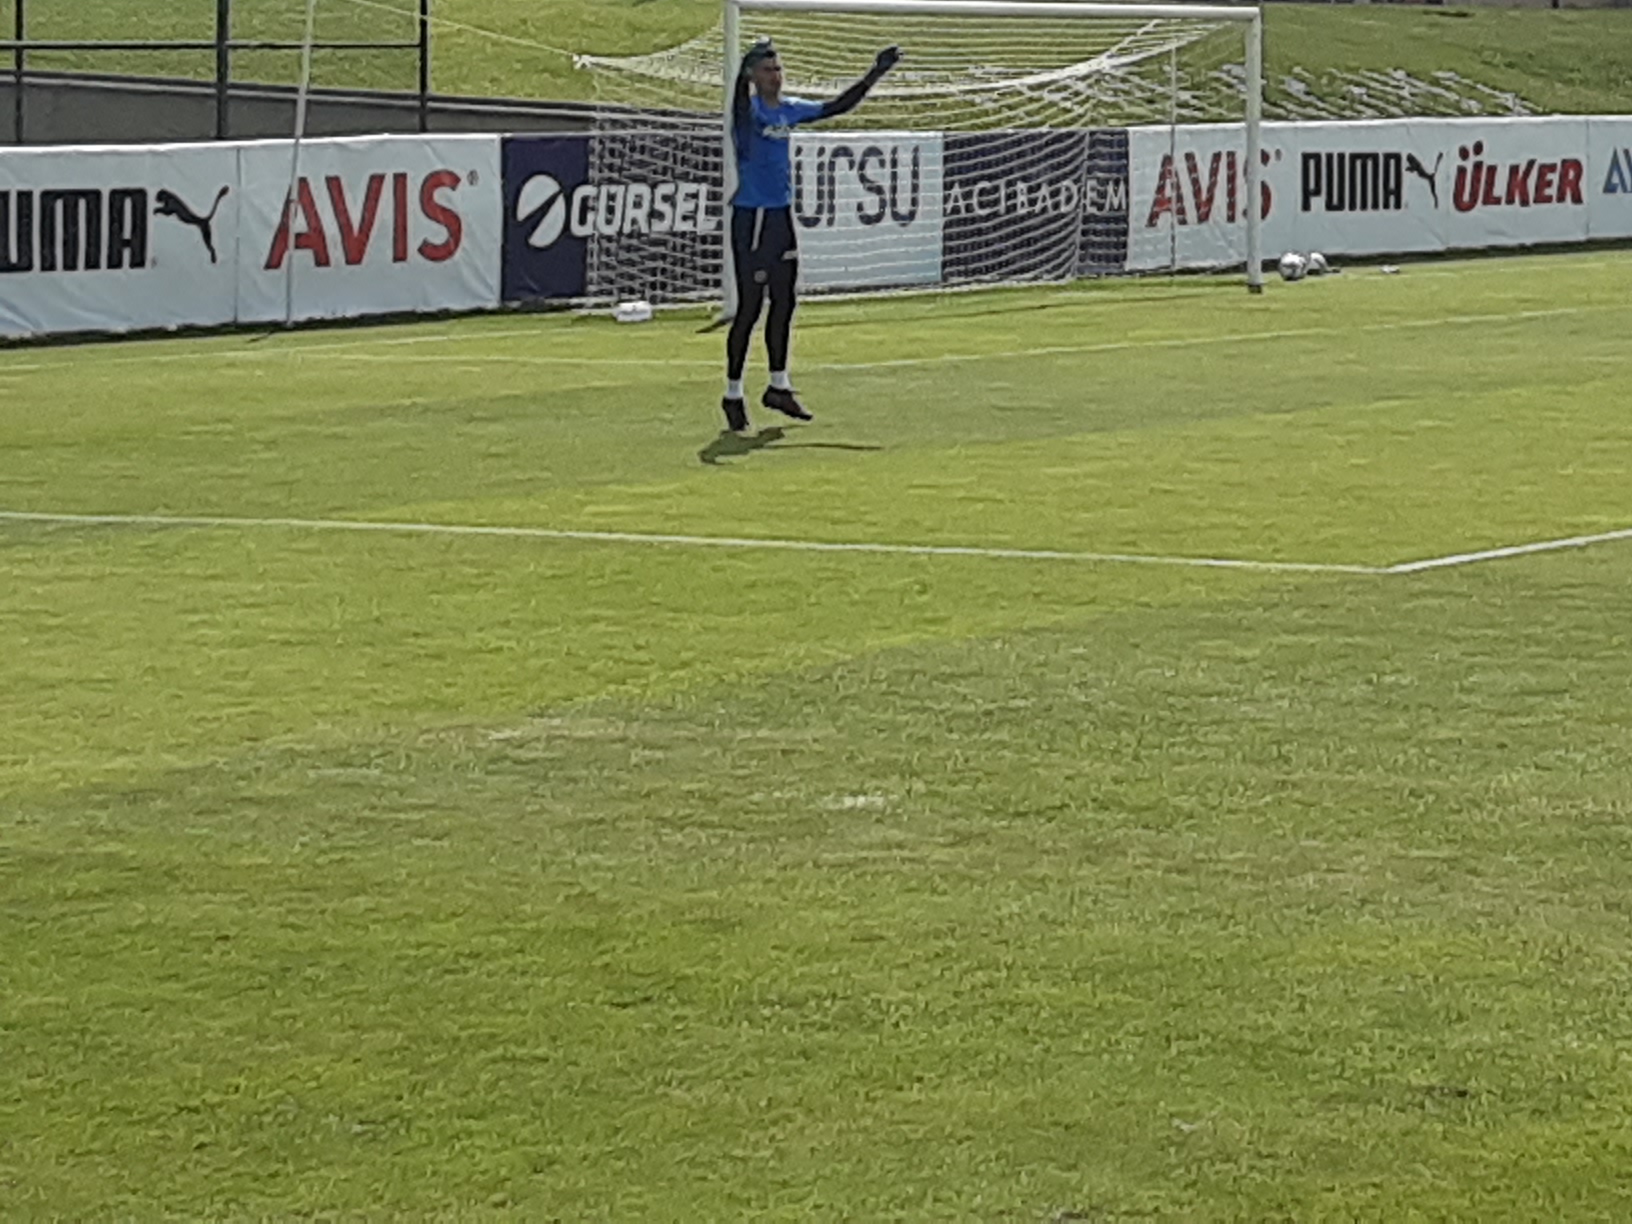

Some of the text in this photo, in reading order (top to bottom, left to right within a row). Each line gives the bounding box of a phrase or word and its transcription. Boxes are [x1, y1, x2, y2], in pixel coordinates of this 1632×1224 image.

[1301, 152, 1402, 211] PUMA
[1453, 141, 1585, 212] ÜLKER
[0, 187, 148, 273] UMA
[263, 169, 463, 270] AVIS
